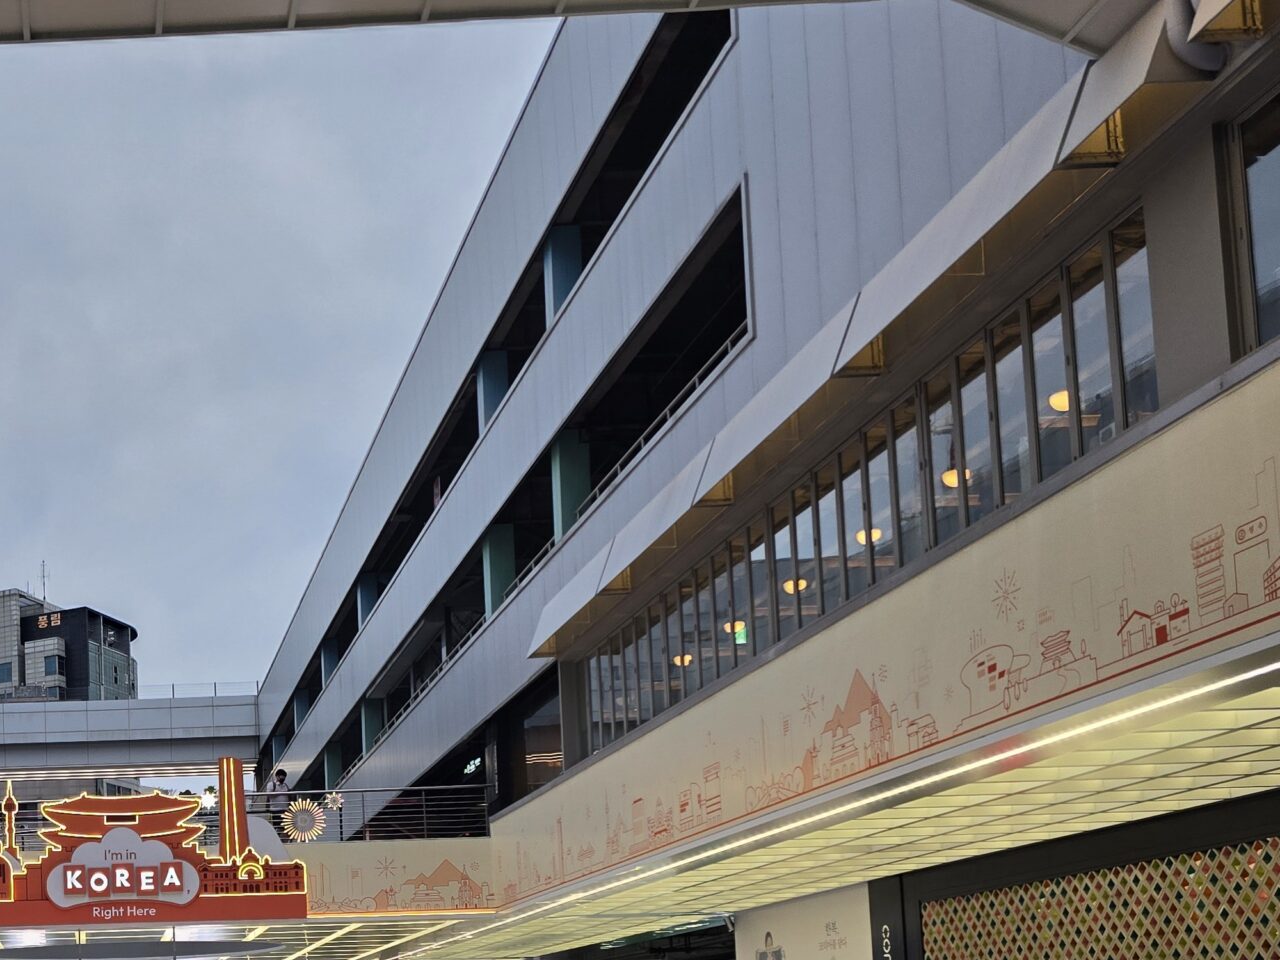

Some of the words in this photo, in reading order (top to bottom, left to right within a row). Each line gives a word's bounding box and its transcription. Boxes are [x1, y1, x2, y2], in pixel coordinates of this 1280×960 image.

[104, 849, 123, 860] I'm
[126, 849, 137, 860] in
[93, 907, 124, 919] Right
[127, 906, 156, 916] Here
